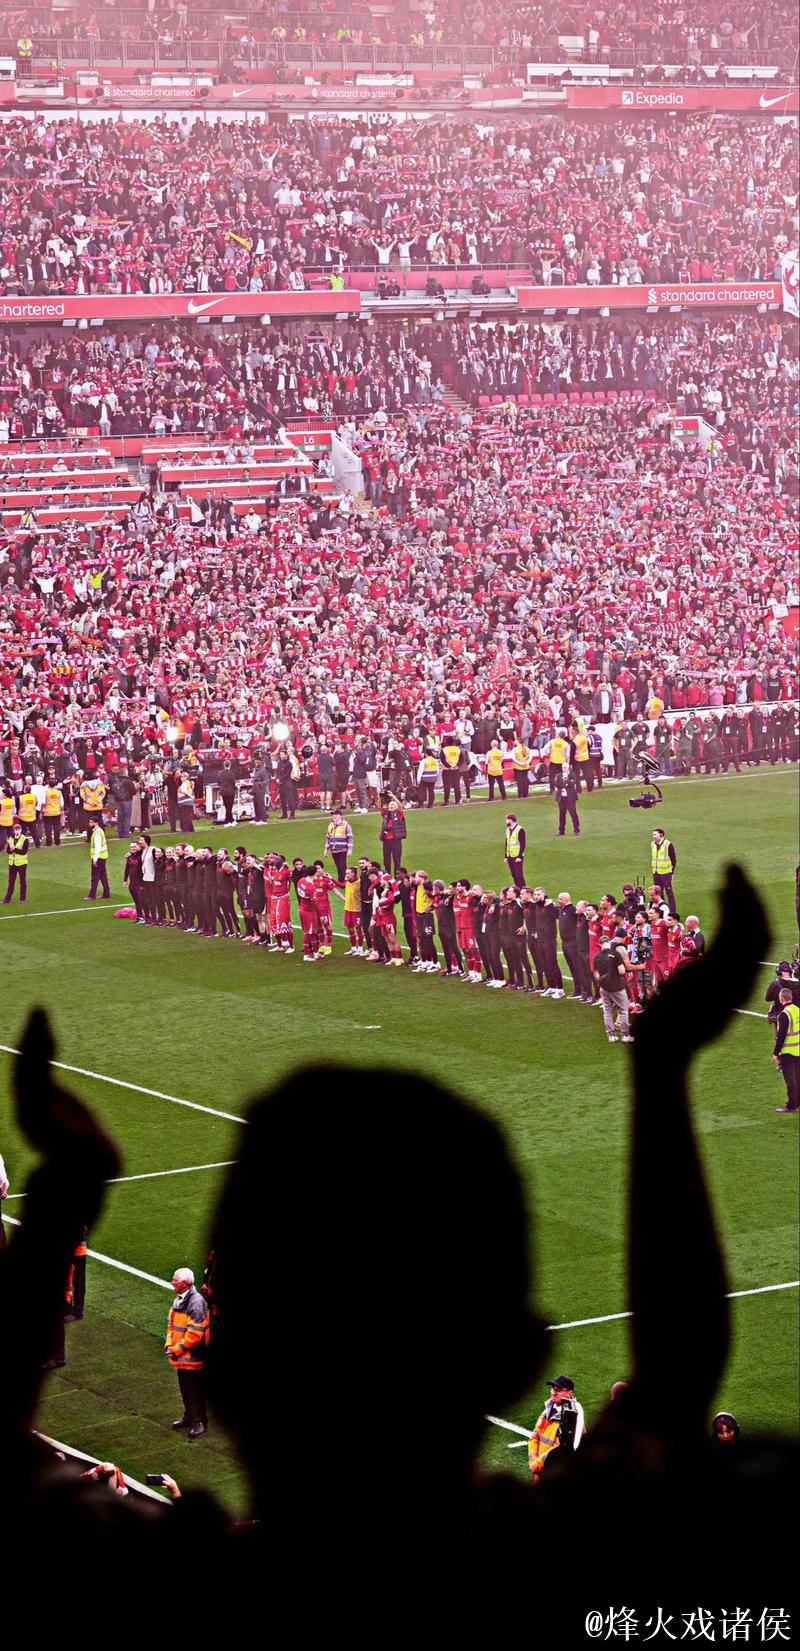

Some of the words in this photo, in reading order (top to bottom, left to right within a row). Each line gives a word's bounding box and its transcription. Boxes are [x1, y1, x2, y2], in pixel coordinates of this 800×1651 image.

[113, 88, 153, 97] standard
[154, 88, 195, 97] chartered
[636, 92, 683, 106] Expedia
[661, 289, 715, 302] standard
[718, 288, 775, 301] chartered
[304, 436, 315, 445] L6
